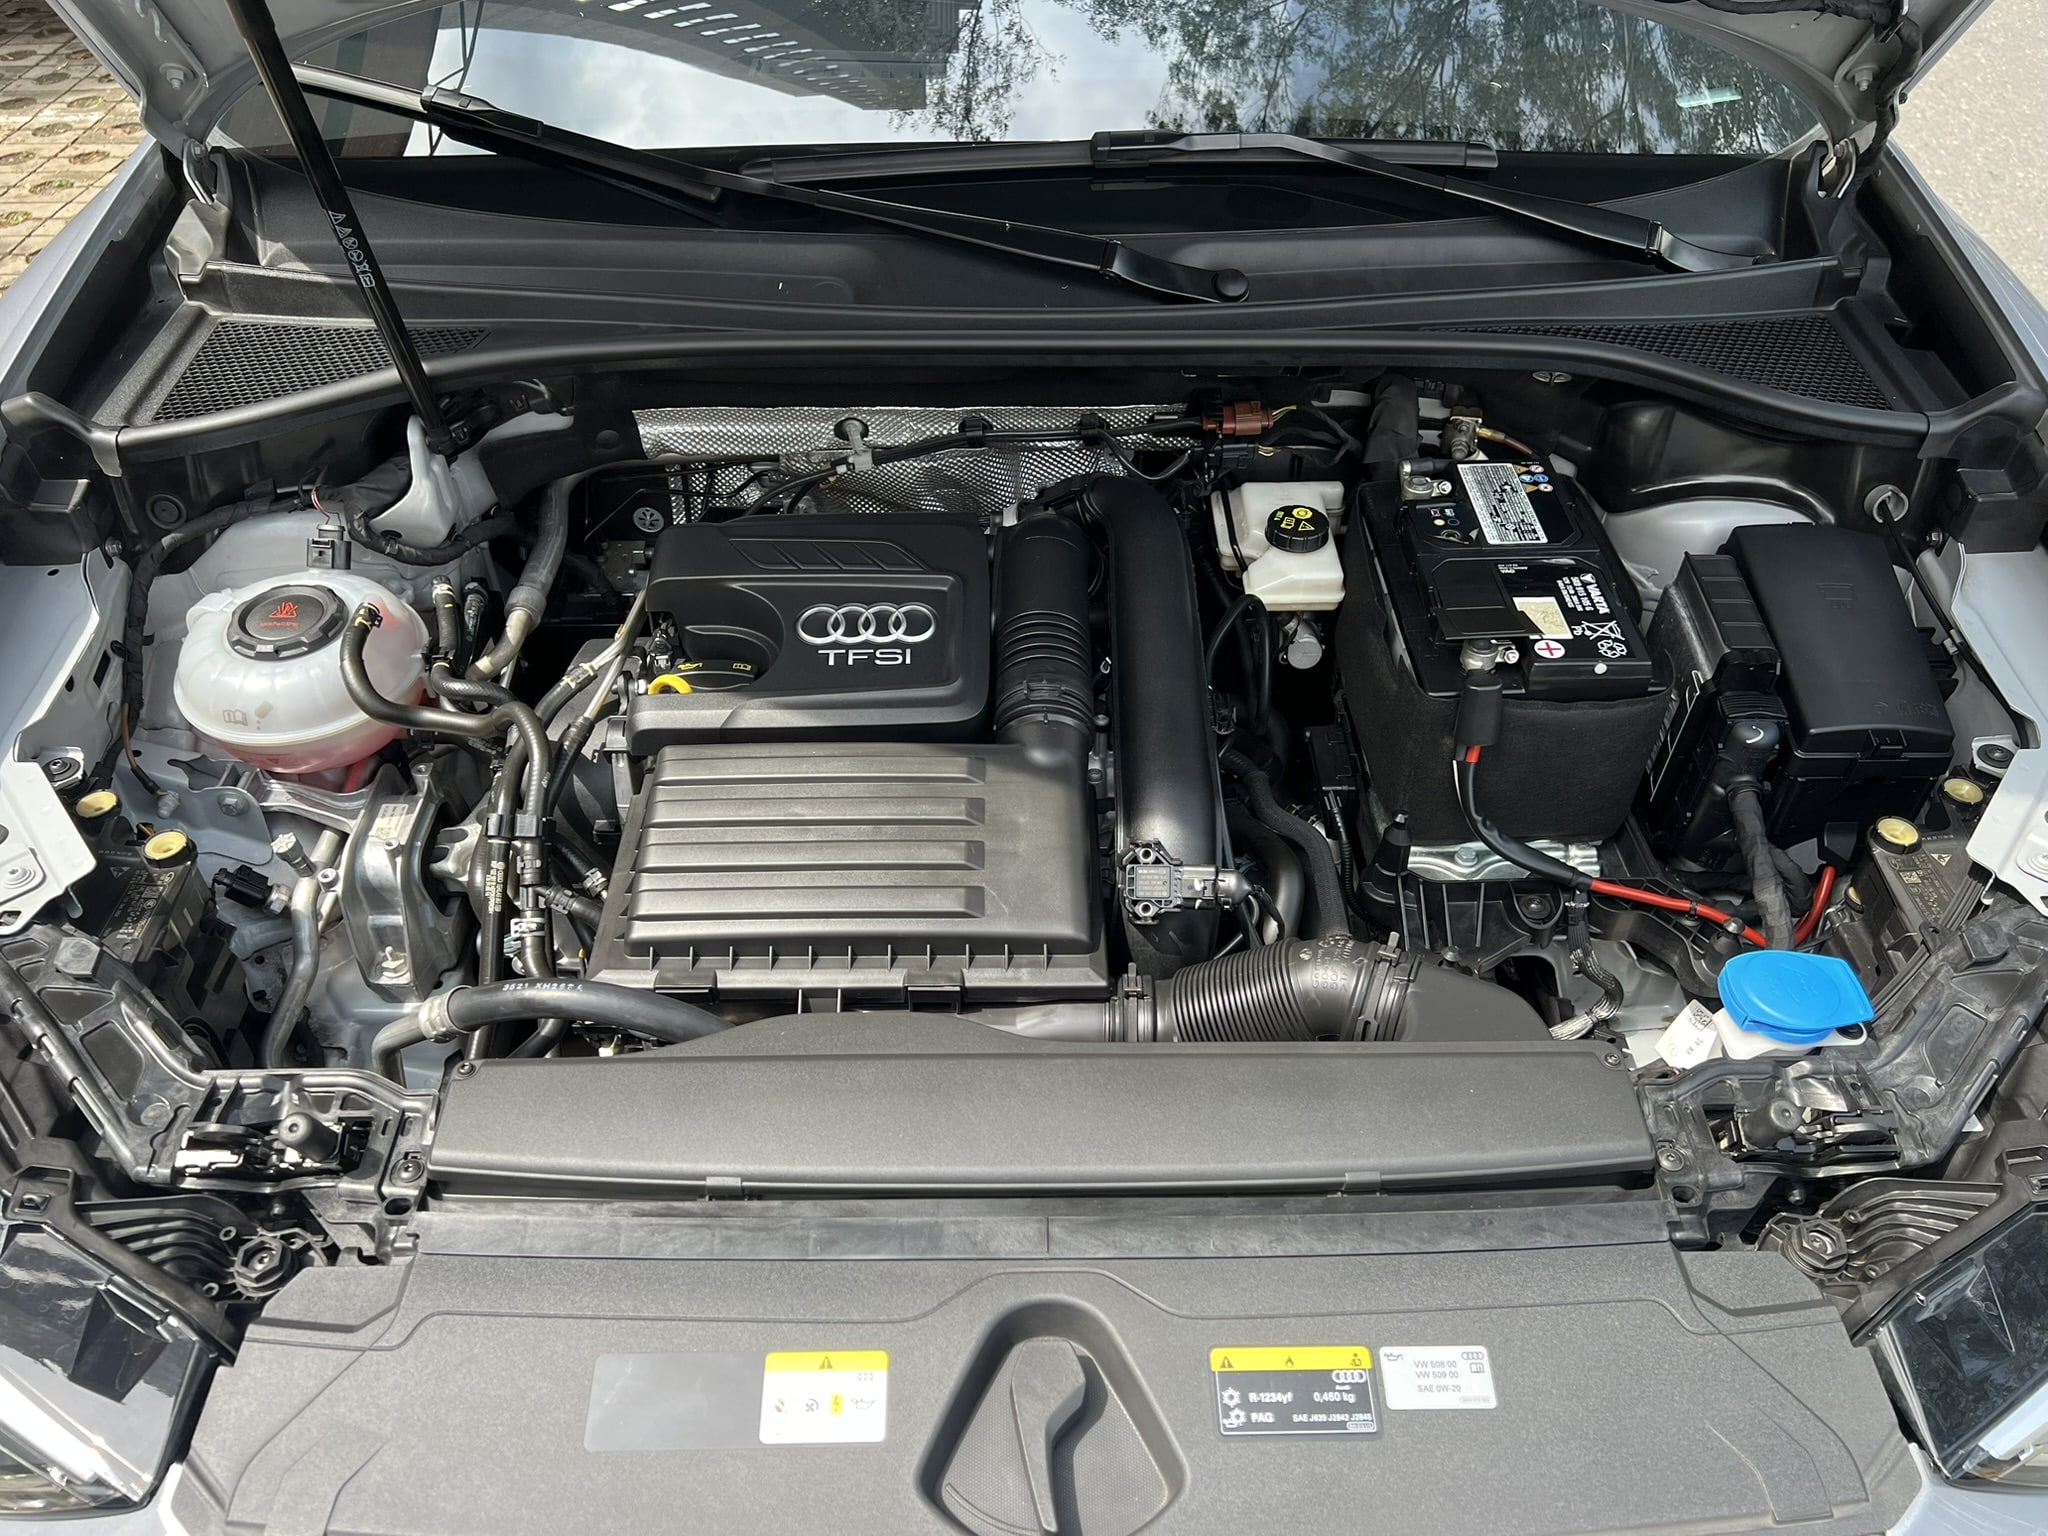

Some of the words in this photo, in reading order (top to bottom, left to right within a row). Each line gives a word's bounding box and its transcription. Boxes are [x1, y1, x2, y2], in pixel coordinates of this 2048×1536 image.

[1586, 583, 1610, 614] VARTA
[1571, 625, 1583, 636] Pb
[818, 648, 912, 666] TFSI
[1414, 1360, 1428, 1369] VW
[1430, 1360, 1446, 1369] 508
[1447, 1360, 1457, 1369] 00
[1415, 1371, 1430, 1379] VW
[1432, 1371, 1447, 1379] 509
[1448, 1371, 1459, 1379] 00
[1417, 1384, 1435, 1392] SAE
[1436, 1384, 1461, 1392] 0W-20
[1248, 1391, 1294, 1404] R-1234yf
[1313, 1391, 1341, 1403] 0,460
[1342, 1391, 1356, 1404] kg
[1250, 1413, 1275, 1423] PAG
[1292, 1414, 1308, 1422] SAE
